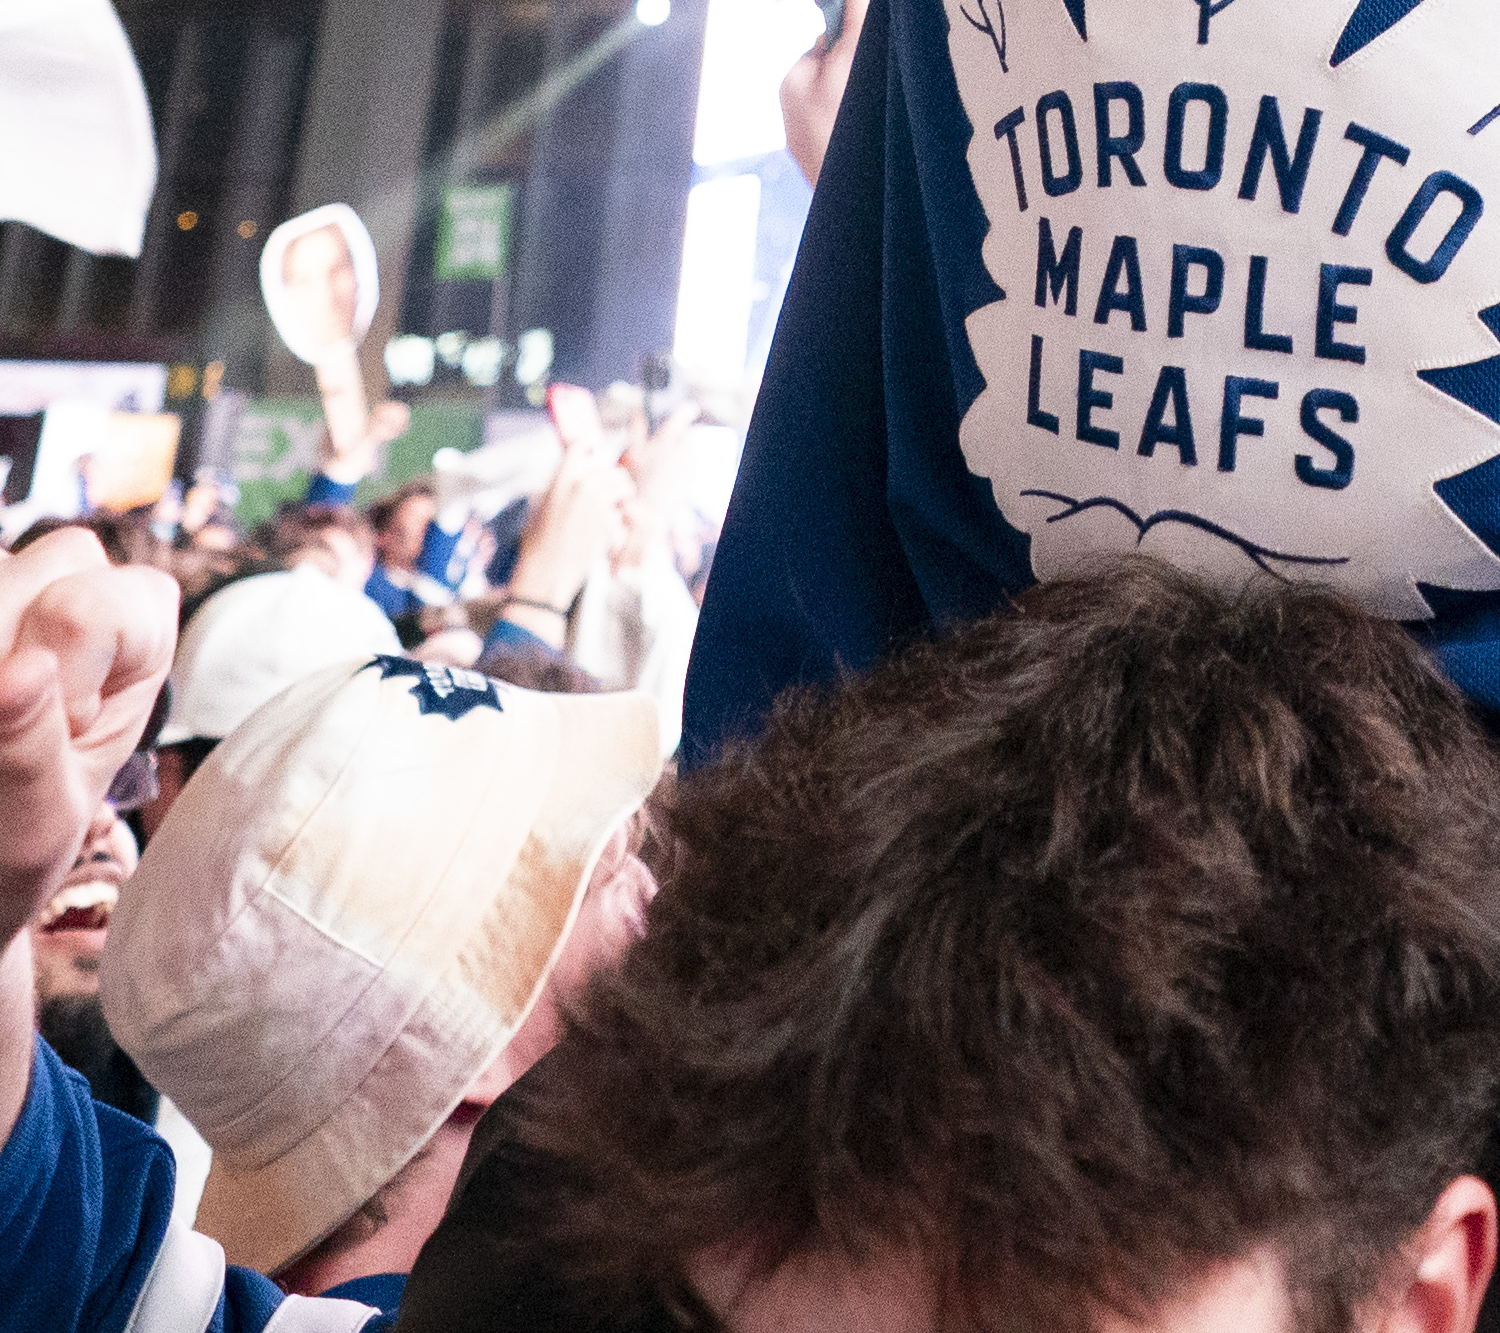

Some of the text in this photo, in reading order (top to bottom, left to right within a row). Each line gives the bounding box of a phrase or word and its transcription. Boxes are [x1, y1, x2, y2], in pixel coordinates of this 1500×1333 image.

[994, 80, 1485, 284] TORONTO
[1034, 216, 1374, 365] MAPLE
[1026, 334, 1360, 490] LEAFS
